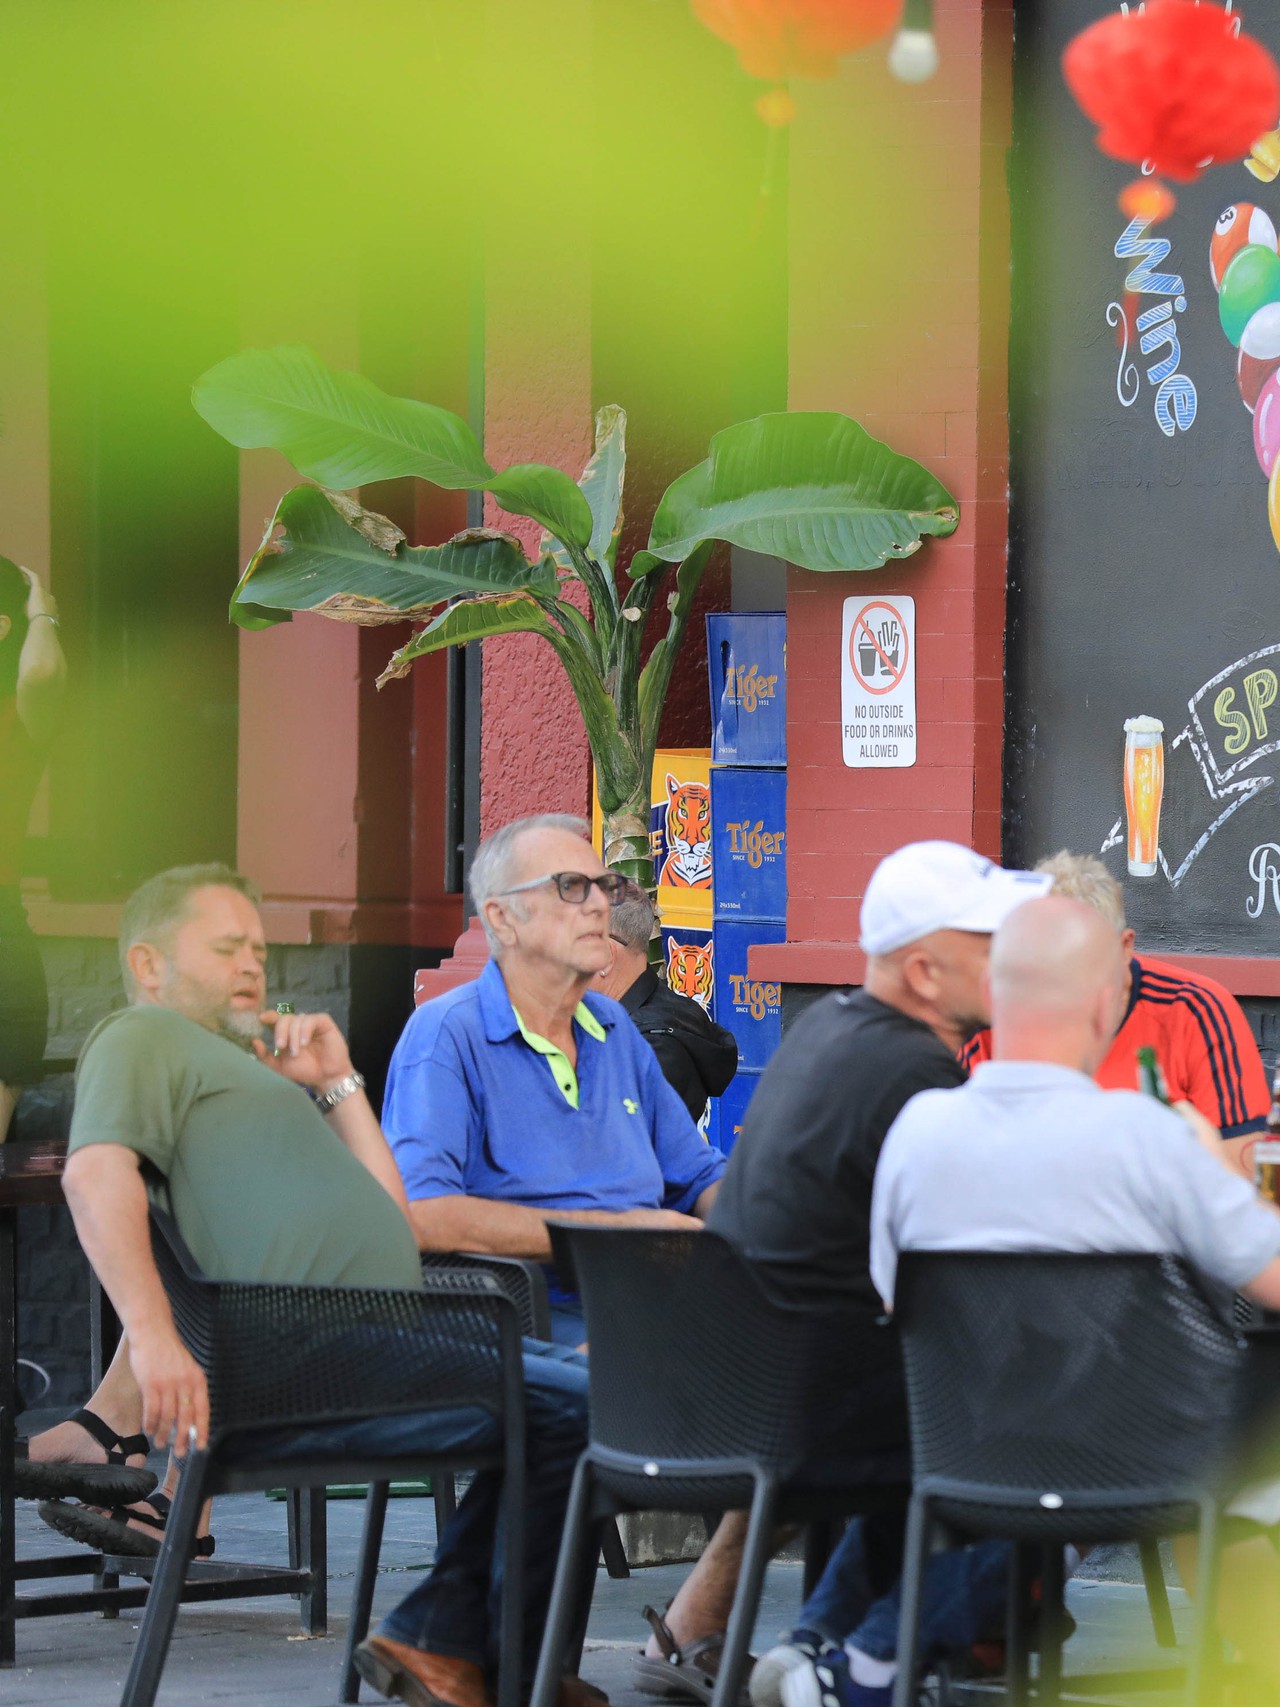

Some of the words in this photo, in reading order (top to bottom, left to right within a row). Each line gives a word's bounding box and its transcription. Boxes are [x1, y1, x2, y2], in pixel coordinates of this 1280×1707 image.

[1114, 214, 1197, 437] Wine
[726, 664, 778, 712] Tiger
[854, 705, 867, 718] NO
[869, 705, 904, 719] OUTSIDE
[844, 725, 867, 738] FOOD
[870, 725, 880, 738] OR
[883, 724, 914, 738] DRINKS
[860, 744, 899, 758] ALLOWED
[726, 820, 785, 868] Tiger
